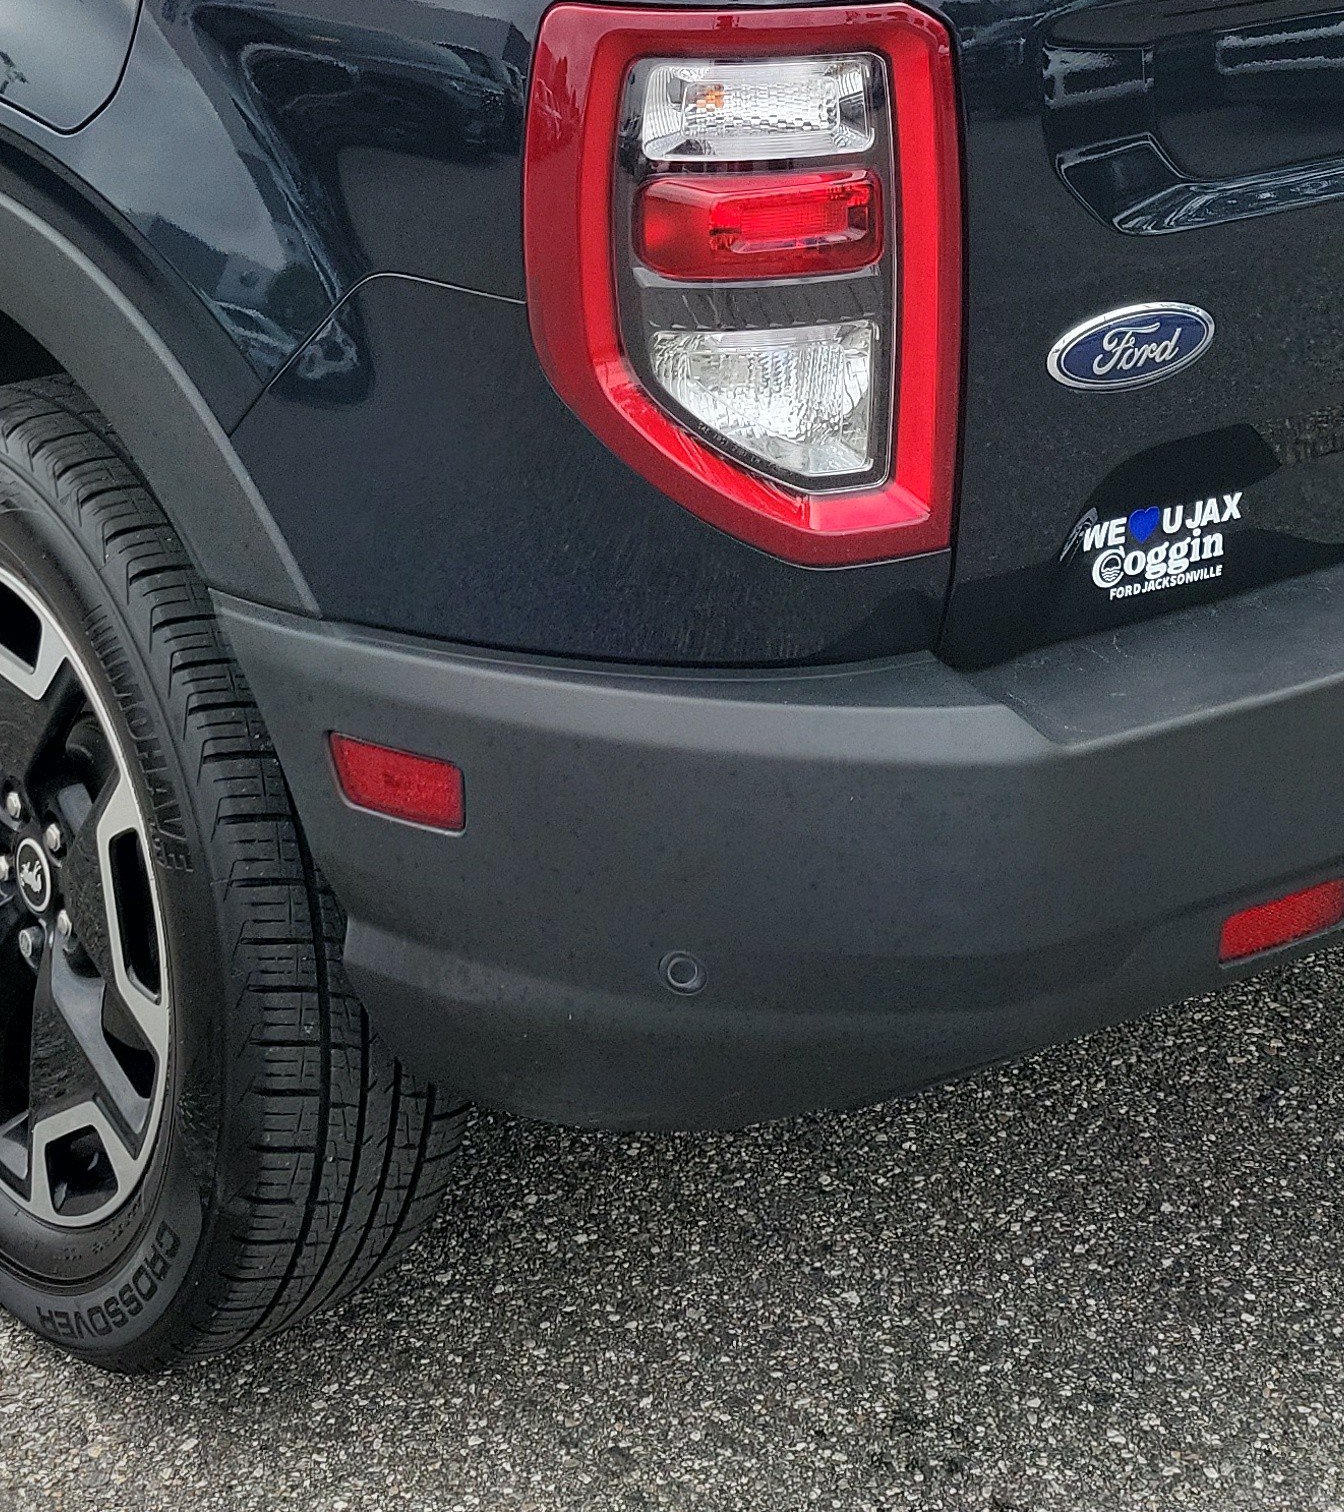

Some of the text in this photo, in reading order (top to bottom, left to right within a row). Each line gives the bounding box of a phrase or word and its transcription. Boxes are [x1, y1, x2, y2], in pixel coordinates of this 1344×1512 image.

[1092, 321, 1181, 375] Ford
[1083, 492, 1243, 552] WE U JAX
[1092, 529, 1225, 589] Coggin
[1109, 565, 1223, 600] FORD JACKSONVILLE
[36, 1220, 181, 1339] CROSSOVER
